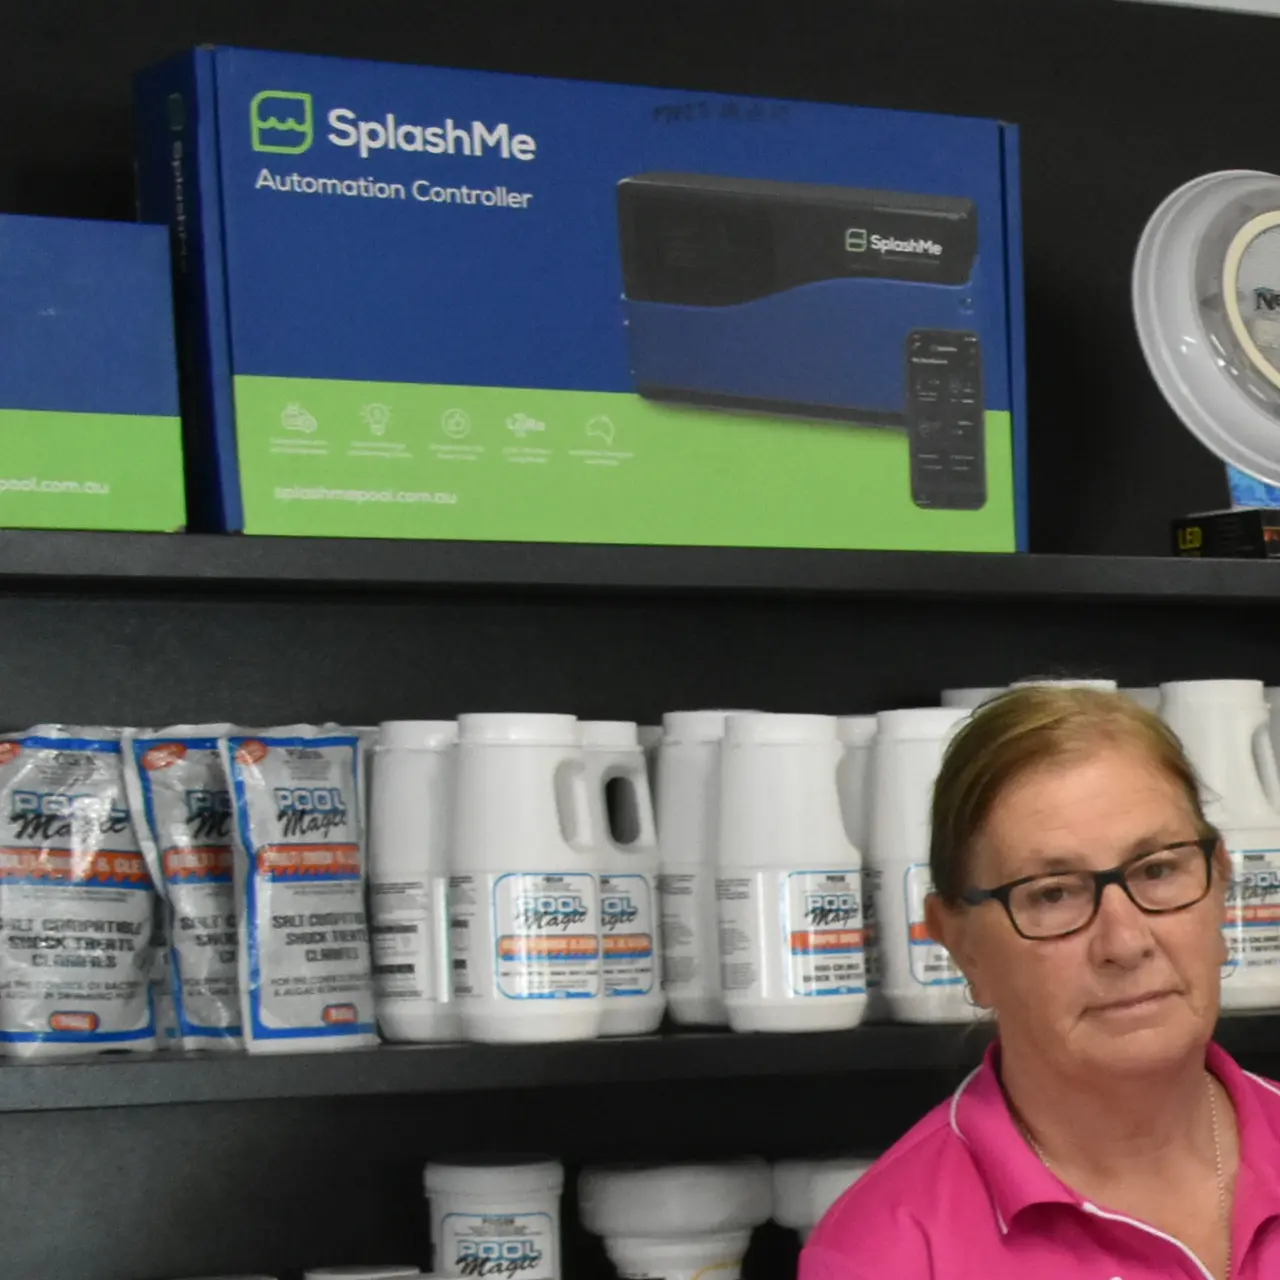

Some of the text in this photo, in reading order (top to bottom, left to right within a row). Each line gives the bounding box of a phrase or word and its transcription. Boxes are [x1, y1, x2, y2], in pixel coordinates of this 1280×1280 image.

[327, 108, 537, 161] SplashMe
[255, 168, 533, 209] Automation Controller
[869, 234, 943, 256] SplashMe
[274, 787, 347, 814] POOL
[457, 1239, 542, 1261] POOL
[456, 1255, 542, 1280] Magic
